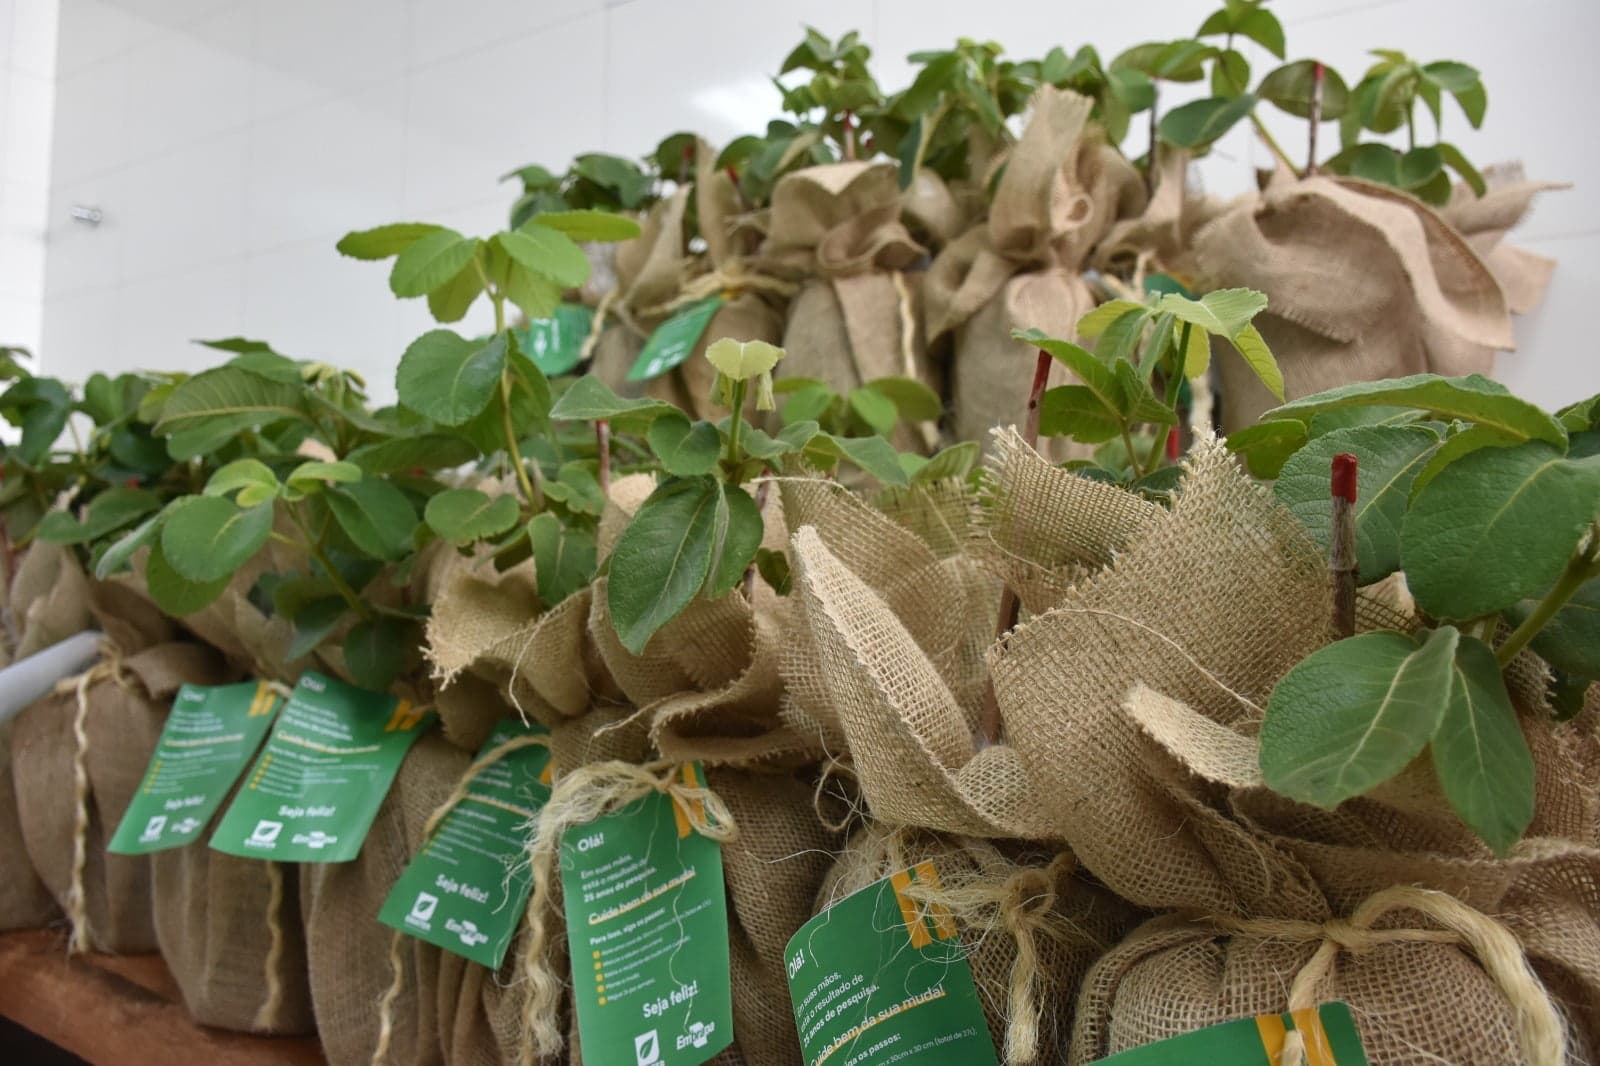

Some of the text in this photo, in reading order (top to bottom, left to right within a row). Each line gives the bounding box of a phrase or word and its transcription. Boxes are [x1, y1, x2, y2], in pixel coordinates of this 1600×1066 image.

[577, 832, 605, 853] Olá!
[435, 873, 459, 893] Seja
[588, 905, 619, 925] Cuide
[619, 897, 641, 914] bem
[789, 949, 805, 980] Olá!
[642, 998, 669, 1018] Seja
[669, 979, 698, 1006] feliz!
[803, 988, 818, 1007] suas
[814, 982, 851, 1014] resultado
[851, 974, 864, 986] de
[809, 1018, 825, 1040] anos
[825, 1009, 836, 1022] de
[836, 984, 880, 1016] pesquisa.
[832, 1024, 860, 1048] bem
[860, 1013, 877, 1031] da
[878, 1003, 901, 1021] sua
[902, 983, 946, 1008] muda!
[858, 1049, 868, 1060] os
[868, 1033, 902, 1056] passos:
